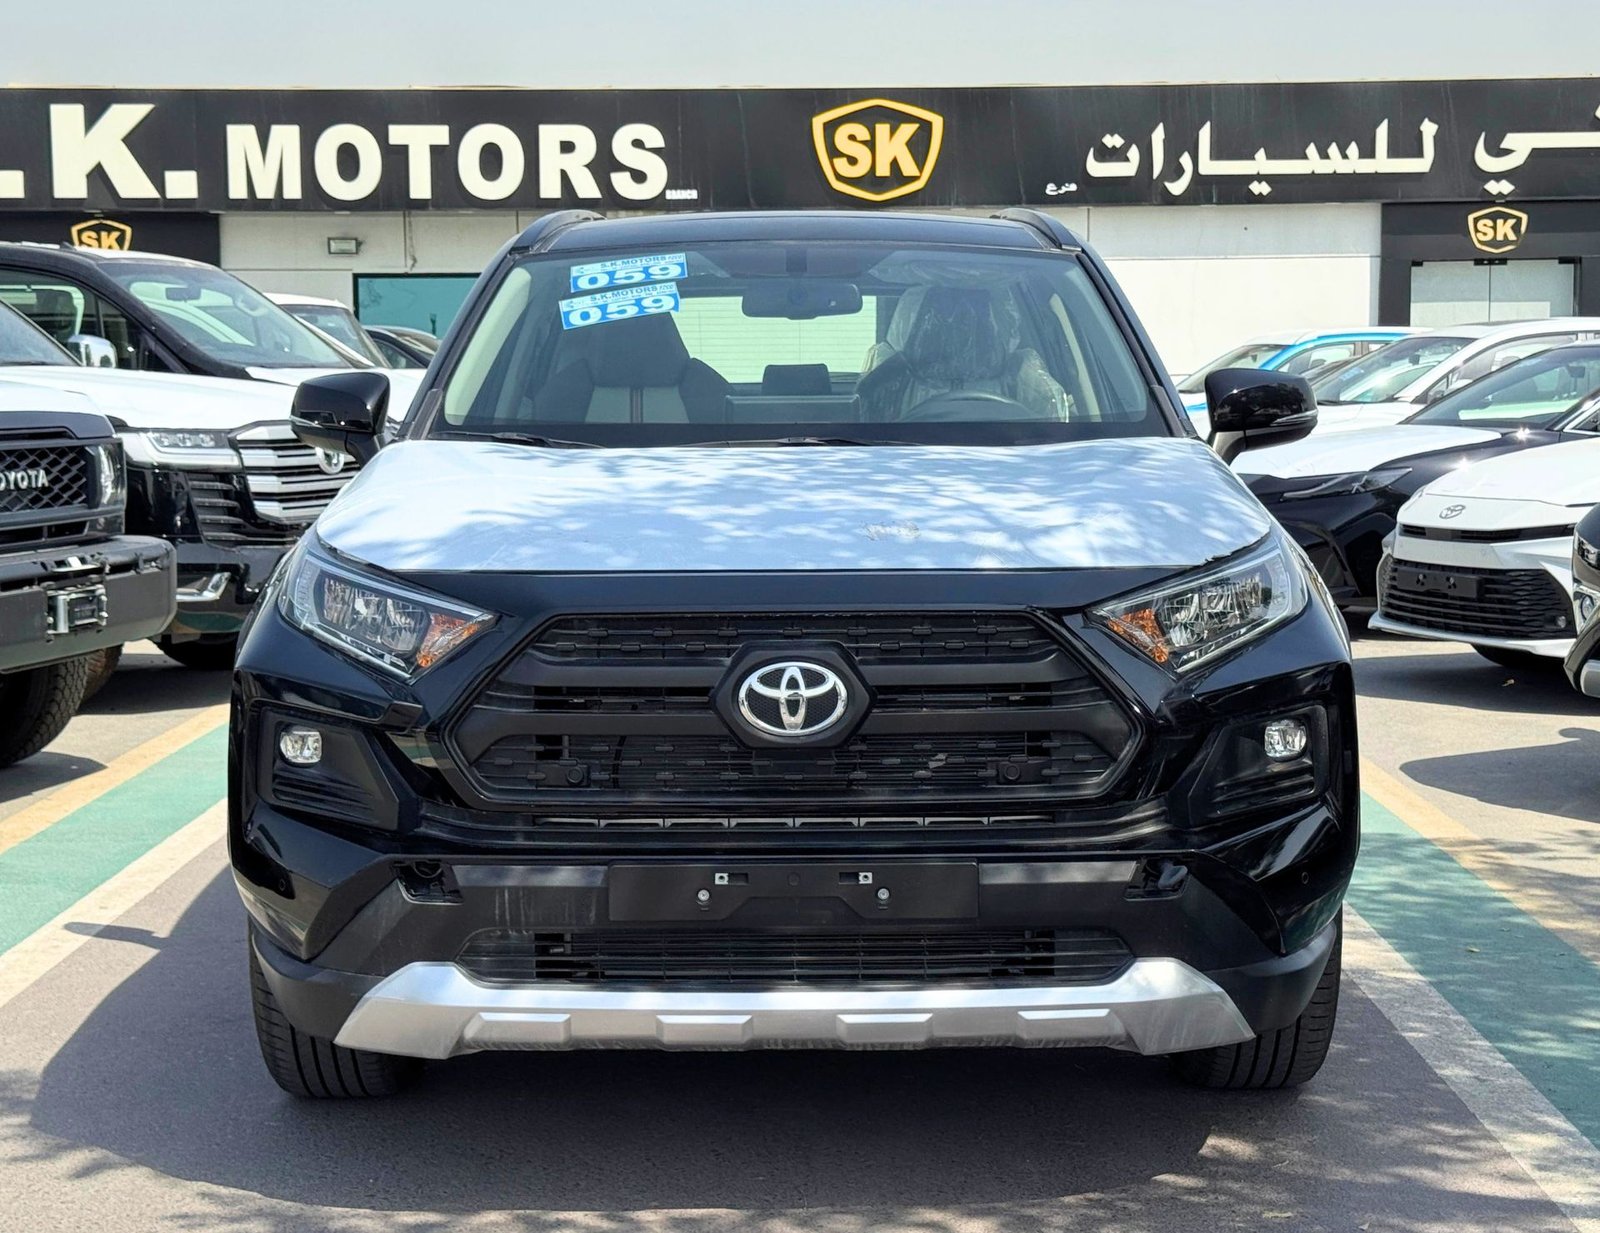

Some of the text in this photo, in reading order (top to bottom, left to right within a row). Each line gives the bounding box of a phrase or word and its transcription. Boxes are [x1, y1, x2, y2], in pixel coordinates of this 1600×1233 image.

[226, 123, 668, 201] MOTORS
[832, 122, 920, 179] SK
[1085, 117, 1439, 196] للسيارات
[1045, 182, 1078, 196] فرع
[80, 230, 121, 250] SK
[1476, 219, 1517, 242] SK
[576, 264, 682, 290] 059
[568, 294, 675, 327] 059
